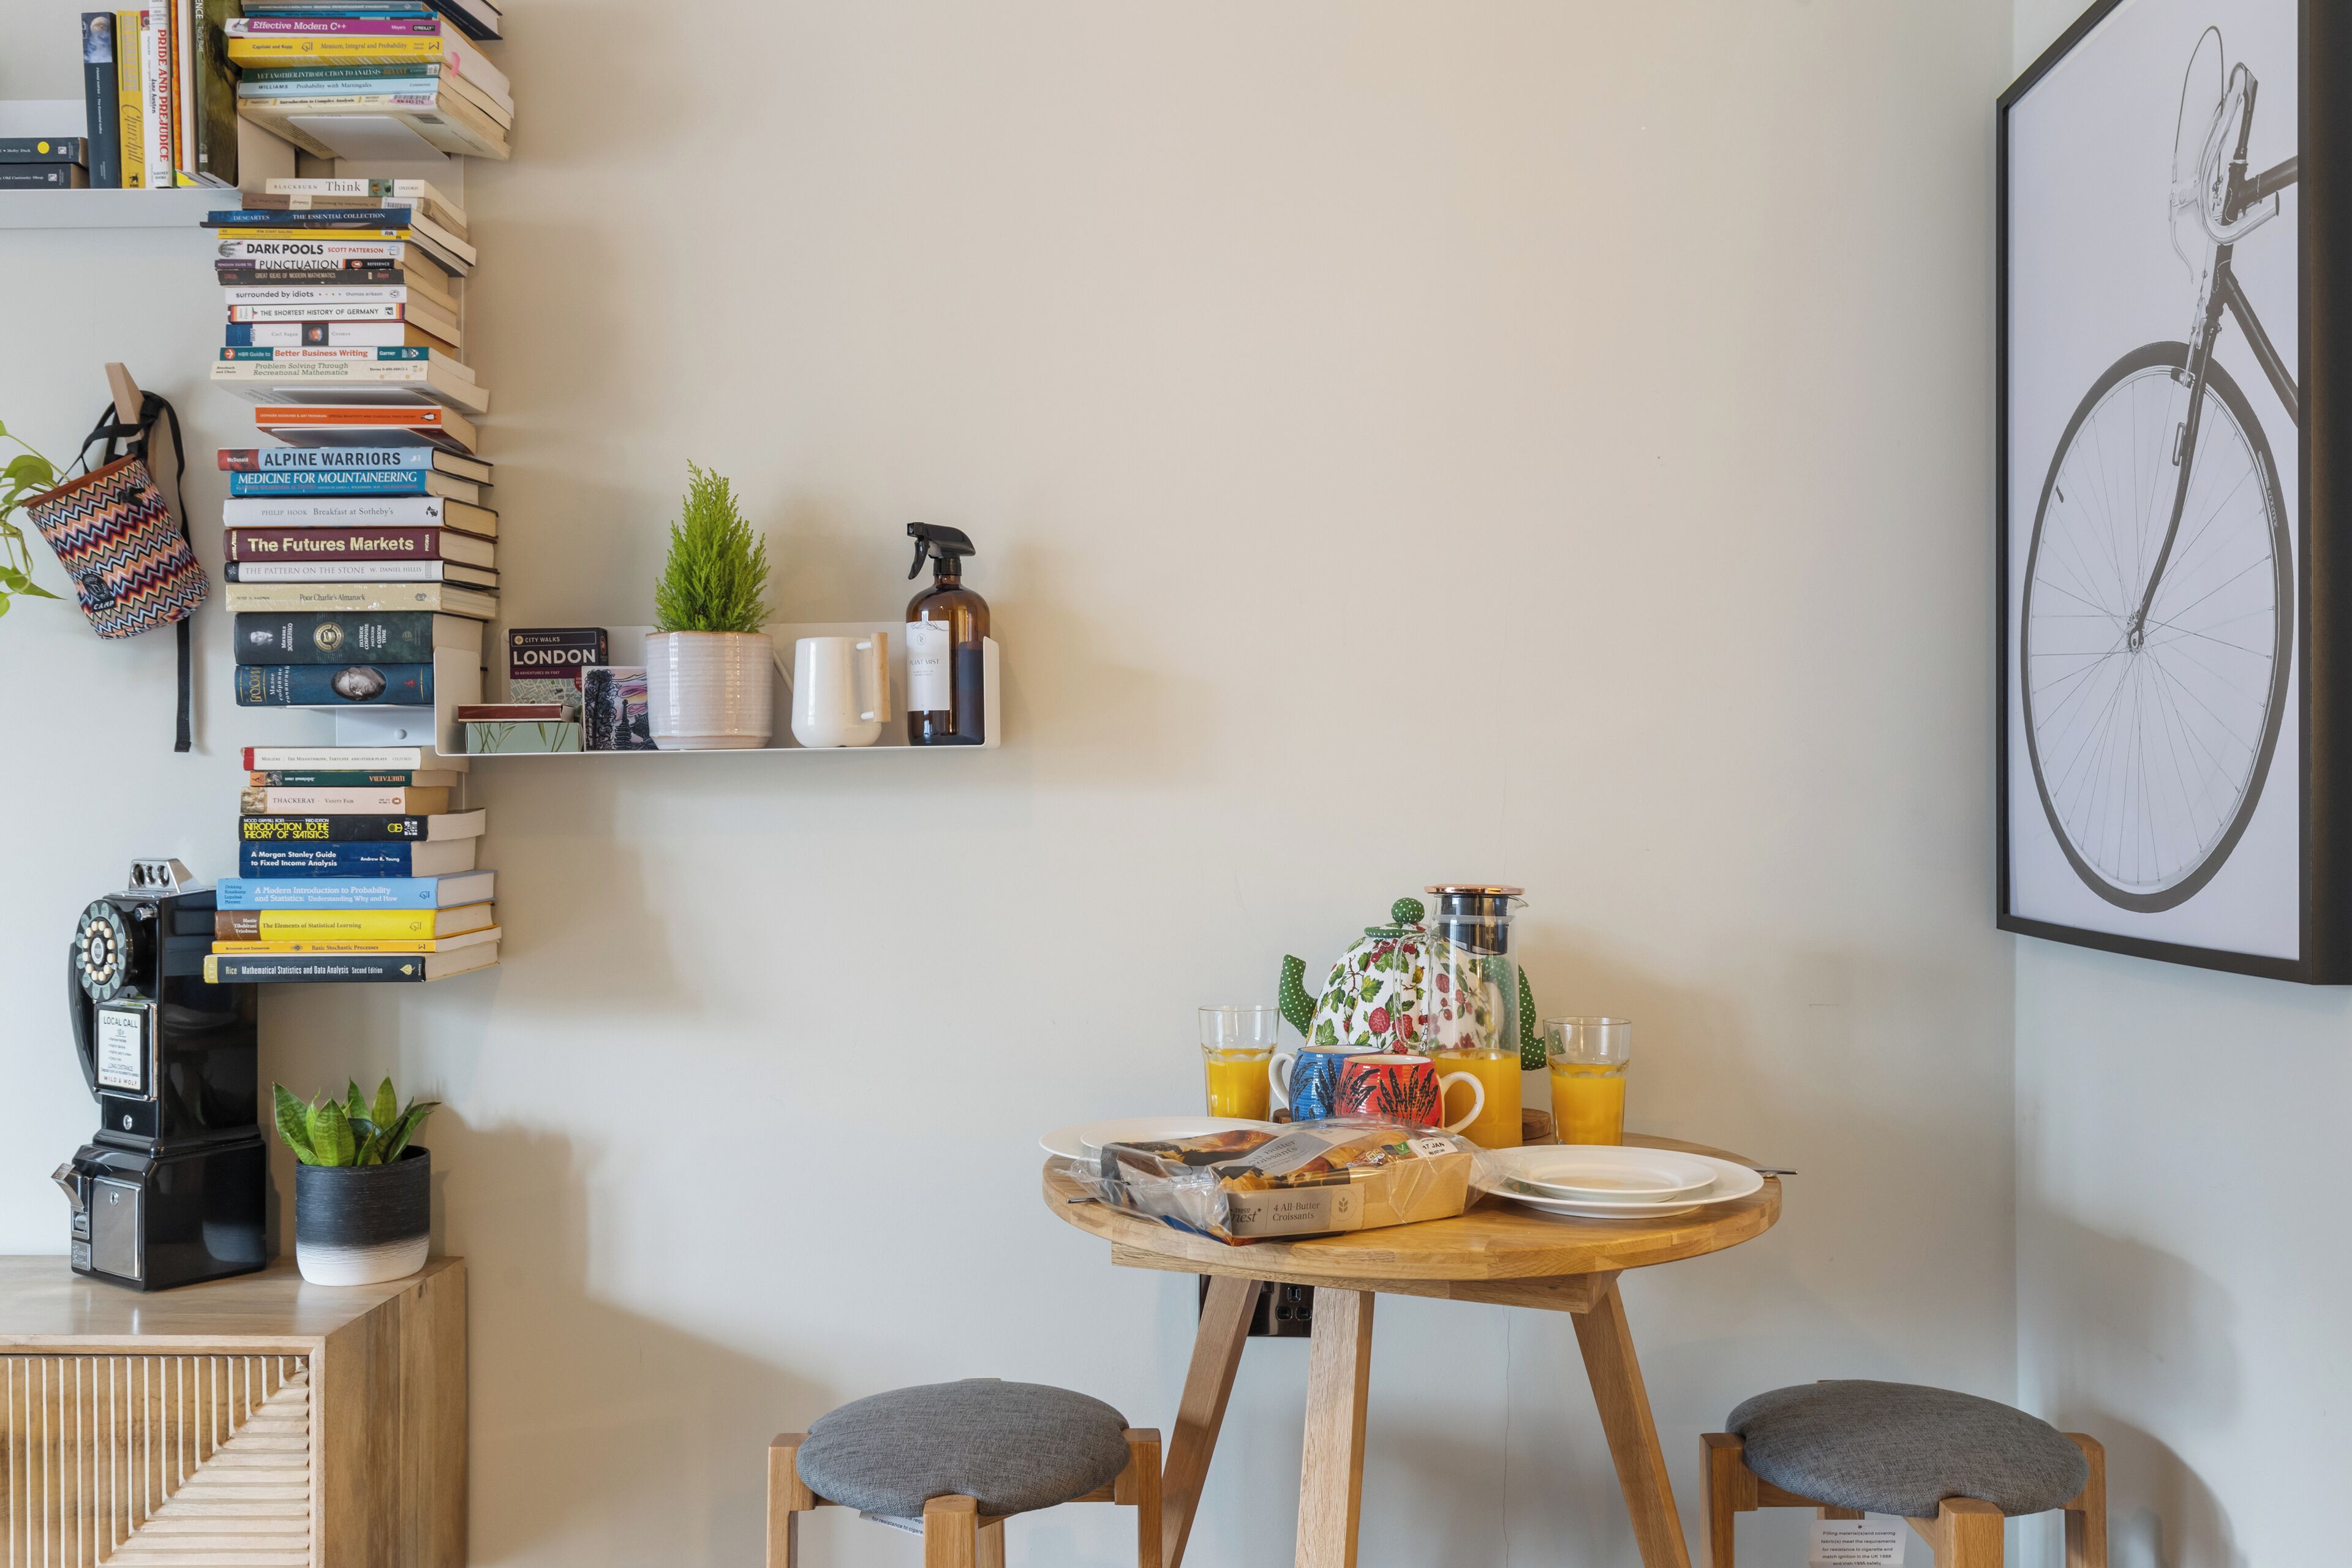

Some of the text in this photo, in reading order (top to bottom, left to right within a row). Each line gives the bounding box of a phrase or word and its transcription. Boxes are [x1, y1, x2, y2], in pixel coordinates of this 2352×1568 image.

[293, 21, 328, 30] Modern
[158, 29, 167, 66] PRIDE
[159, 67, 167, 93] AND
[121, 104, 143, 164] Churchill
[159, 96, 168, 162] PREJUDICE
[326, 181, 361, 192] Think
[247, 244, 323, 255] DARK POOLS
[260, 260, 339, 270] PUNCTUATION
[264, 452, 401, 466] ALPINE WARRIORS
[238, 471, 417, 484] MEDICINE FOR MOUNTAINEERING
[359, 507, 393, 517] Sotheby's
[247, 537, 414, 552] The Futures Markets
[93, 600, 115, 610] CAMP
[513, 649, 595, 665] LONDON
[350, 886, 391, 895] Probability
[225, 966, 237, 974] Rice
[242, 965, 276, 974] Mathematical
[277, 965, 301, 974] Statistics
[303, 965, 312, 974] and
[314, 966, 326, 974] Data
[326, 965, 349, 975] Analysis
[103, 1016, 138, 1028] LOCAL CALL
[1281, 1202, 1321, 1212] All-Butter
[1272, 1212, 1314, 1221] Croissants
[878, 1519, 903, 1529] resistance
